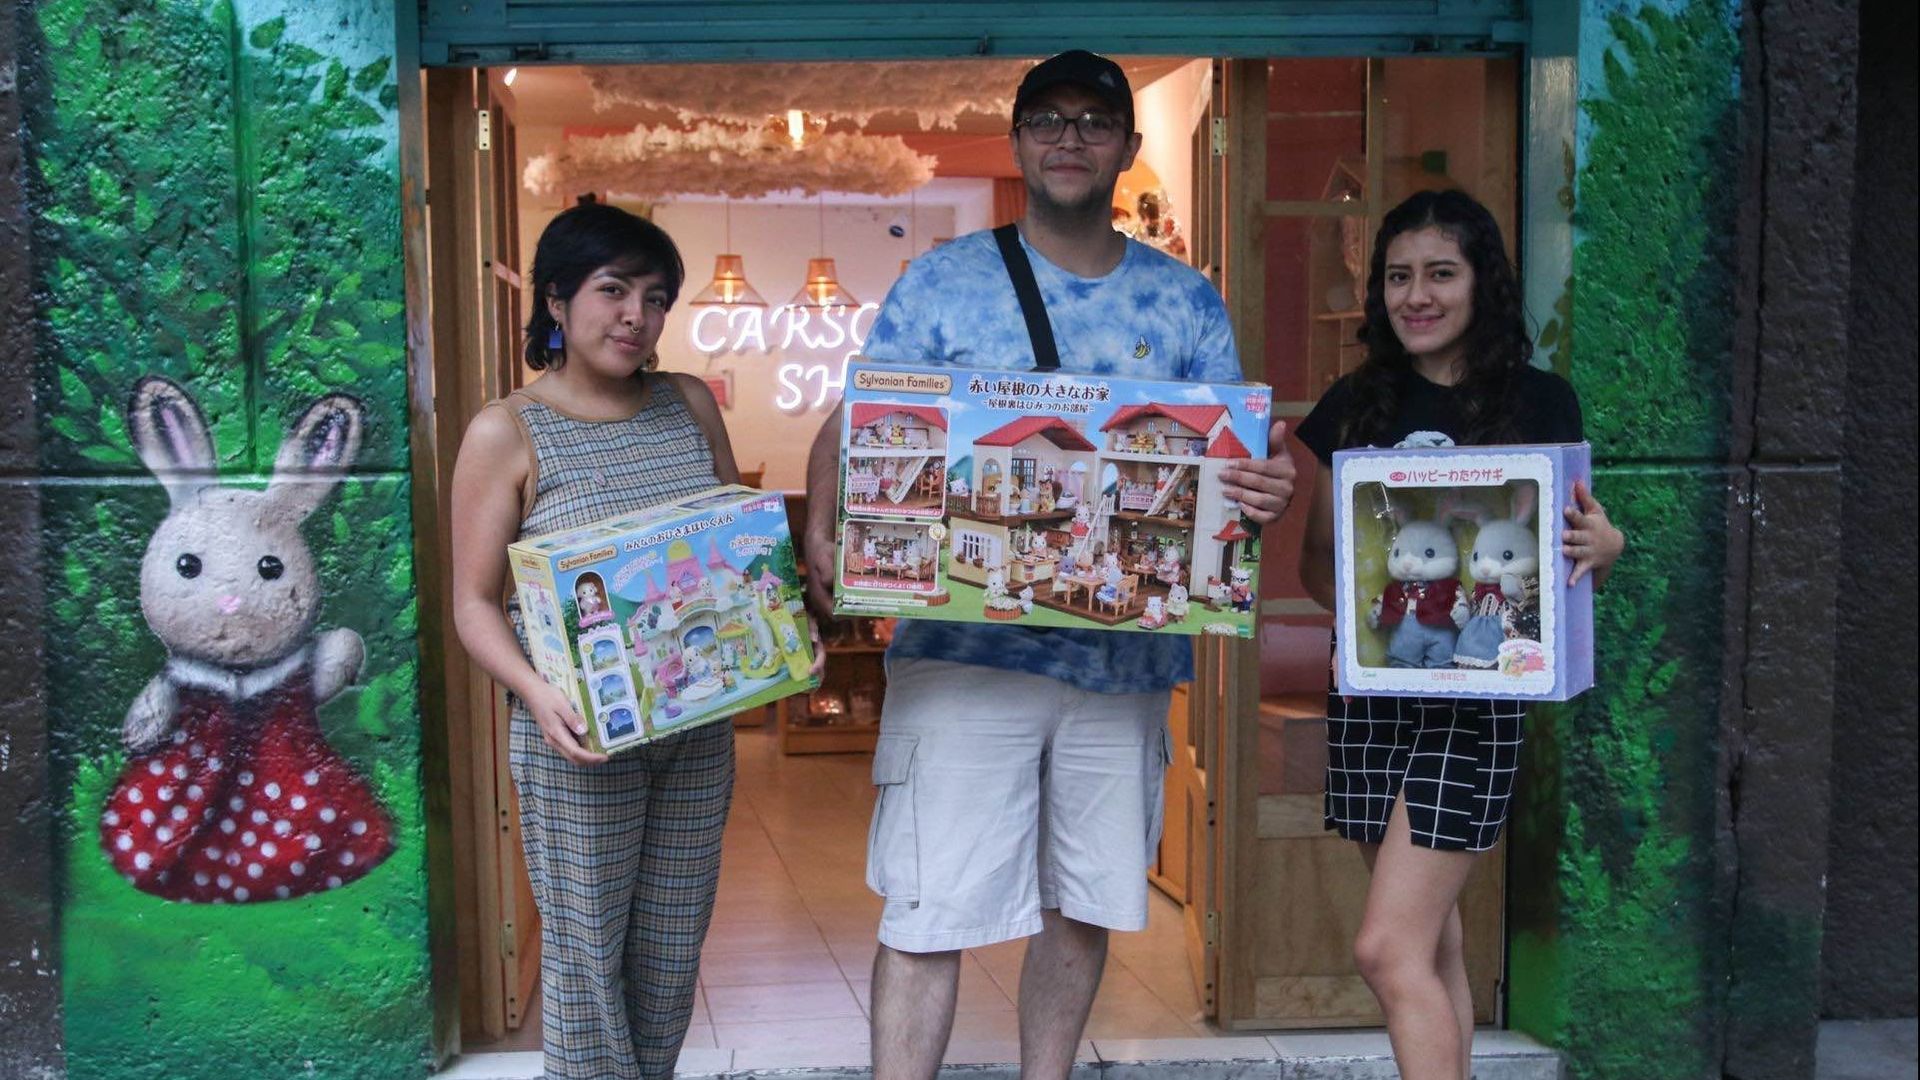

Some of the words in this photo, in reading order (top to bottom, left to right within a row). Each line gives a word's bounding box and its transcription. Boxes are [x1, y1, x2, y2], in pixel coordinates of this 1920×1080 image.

[859, 373, 905, 388] Sylvanian
[907, 376, 945, 389] Families
[969, 379, 1110, 401] 赤い屋根の大きなお家
[1408, 468, 1503, 482] ハッピーわたウサギ
[559, 556, 590, 569] Sylvanian
[589, 549, 614, 561] Families
